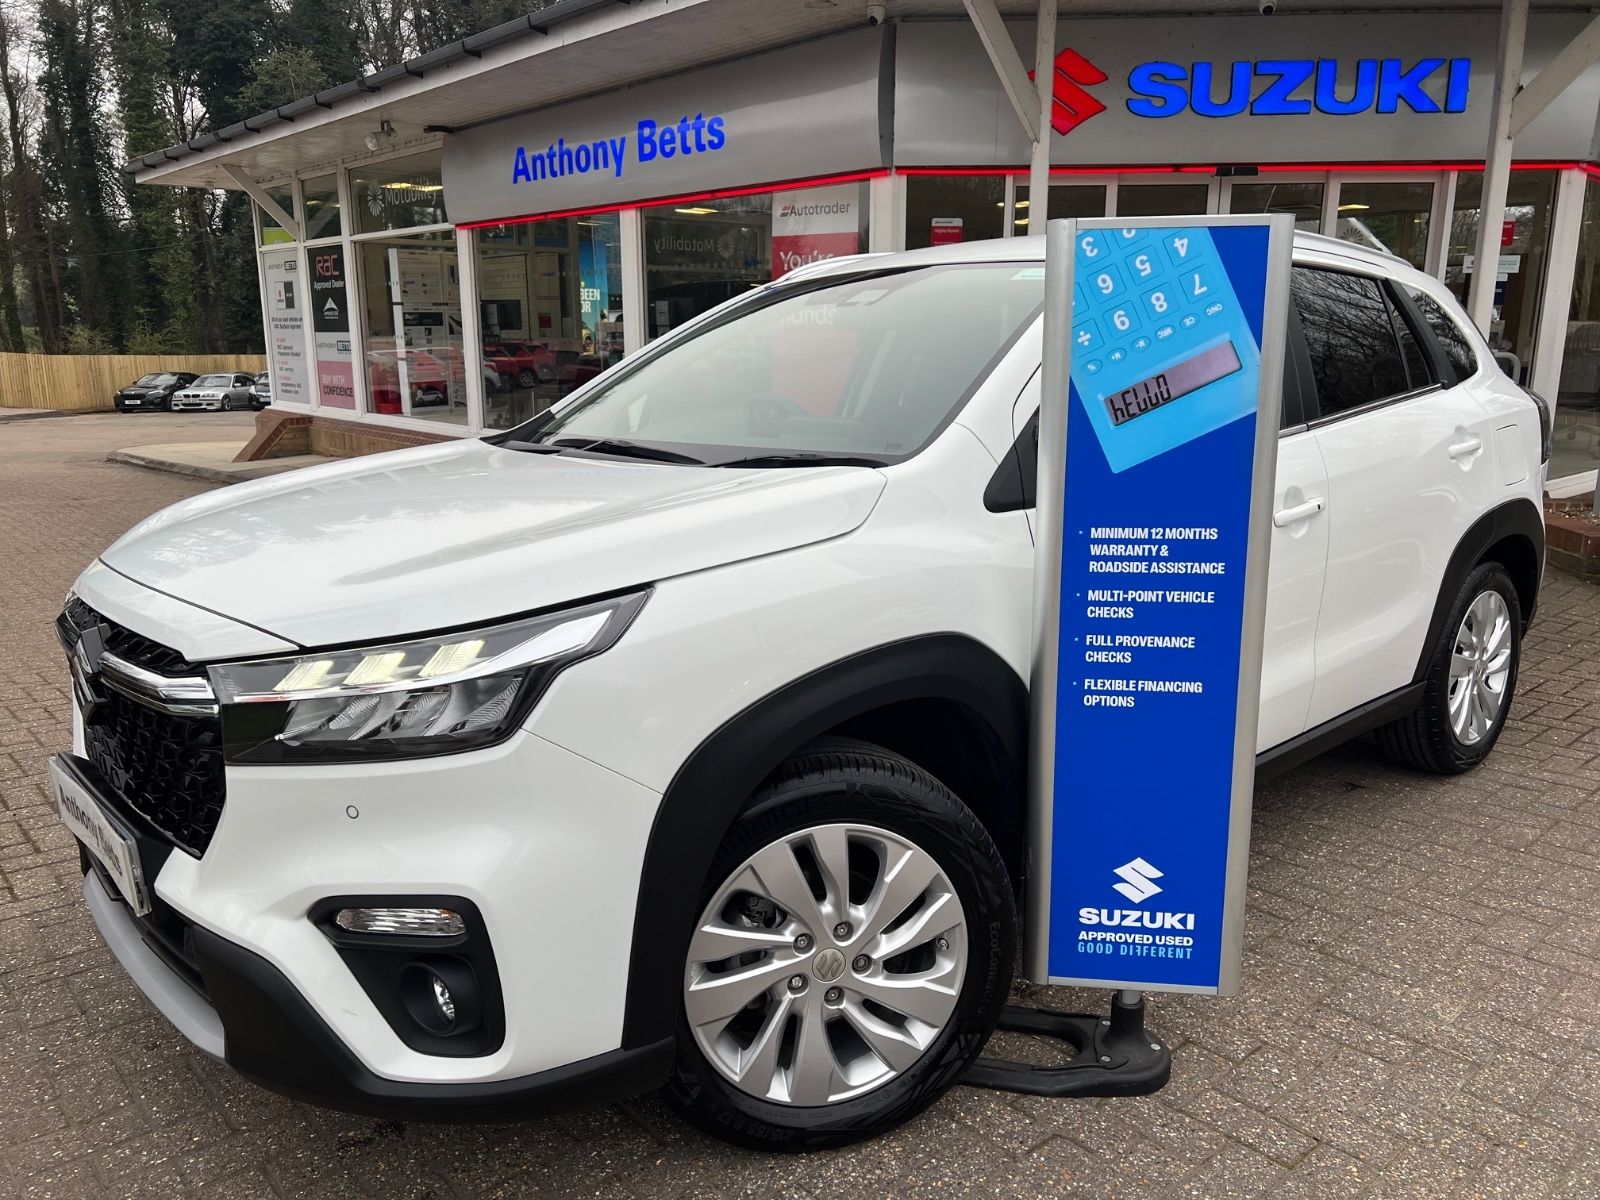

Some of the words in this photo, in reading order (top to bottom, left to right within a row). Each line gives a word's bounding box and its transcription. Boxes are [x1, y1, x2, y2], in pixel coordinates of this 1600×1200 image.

[1128, 59, 1471, 116] SUZUKI
[513, 136, 626, 182] Anthony
[637, 113, 725, 163] Betts
[789, 202, 850, 217] Autotrader
[1081, 236, 1098, 257] 3
[1173, 237, 1189, 258] 4
[1135, 254, 1152, 277] 5
[1193, 273, 1208, 296] 7
[1151, 291, 1168, 313] 8
[323, 385, 354, 397] CONFIDENCE
[1090, 527, 1148, 540] MINIMUM
[1150, 527, 1163, 540] 12
[1165, 527, 1218, 540] MONTHS
[1090, 544, 1159, 556] WARRANTY
[1160, 544, 1169, 557] &
[1089, 561, 1149, 573] ROADSIDE
[1150, 561, 1225, 574] ASSISTANCE
[1087, 589, 1164, 603] MULTI-POINT
[1166, 591, 1215, 603] VEHICLE
[1087, 606, 1134, 619] CHECKS
[1086, 634, 1114, 647] FULL
[1115, 635, 1195, 648] PROVENANCE
[1085, 651, 1132, 664] CHECKS
[1084, 679, 1137, 692] FLEXIBLE
[1138, 680, 1203, 694] FINANCING
[1083, 694, 1135, 708] OPTIONS
[1078, 907, 1195, 931] SUZUKI
[1078, 930, 1153, 945] APPROVED
[1155, 935, 1194, 947] USED
[1078, 941, 1113, 955] GOOD
[1120, 943, 1193, 960] DIFFERENT
